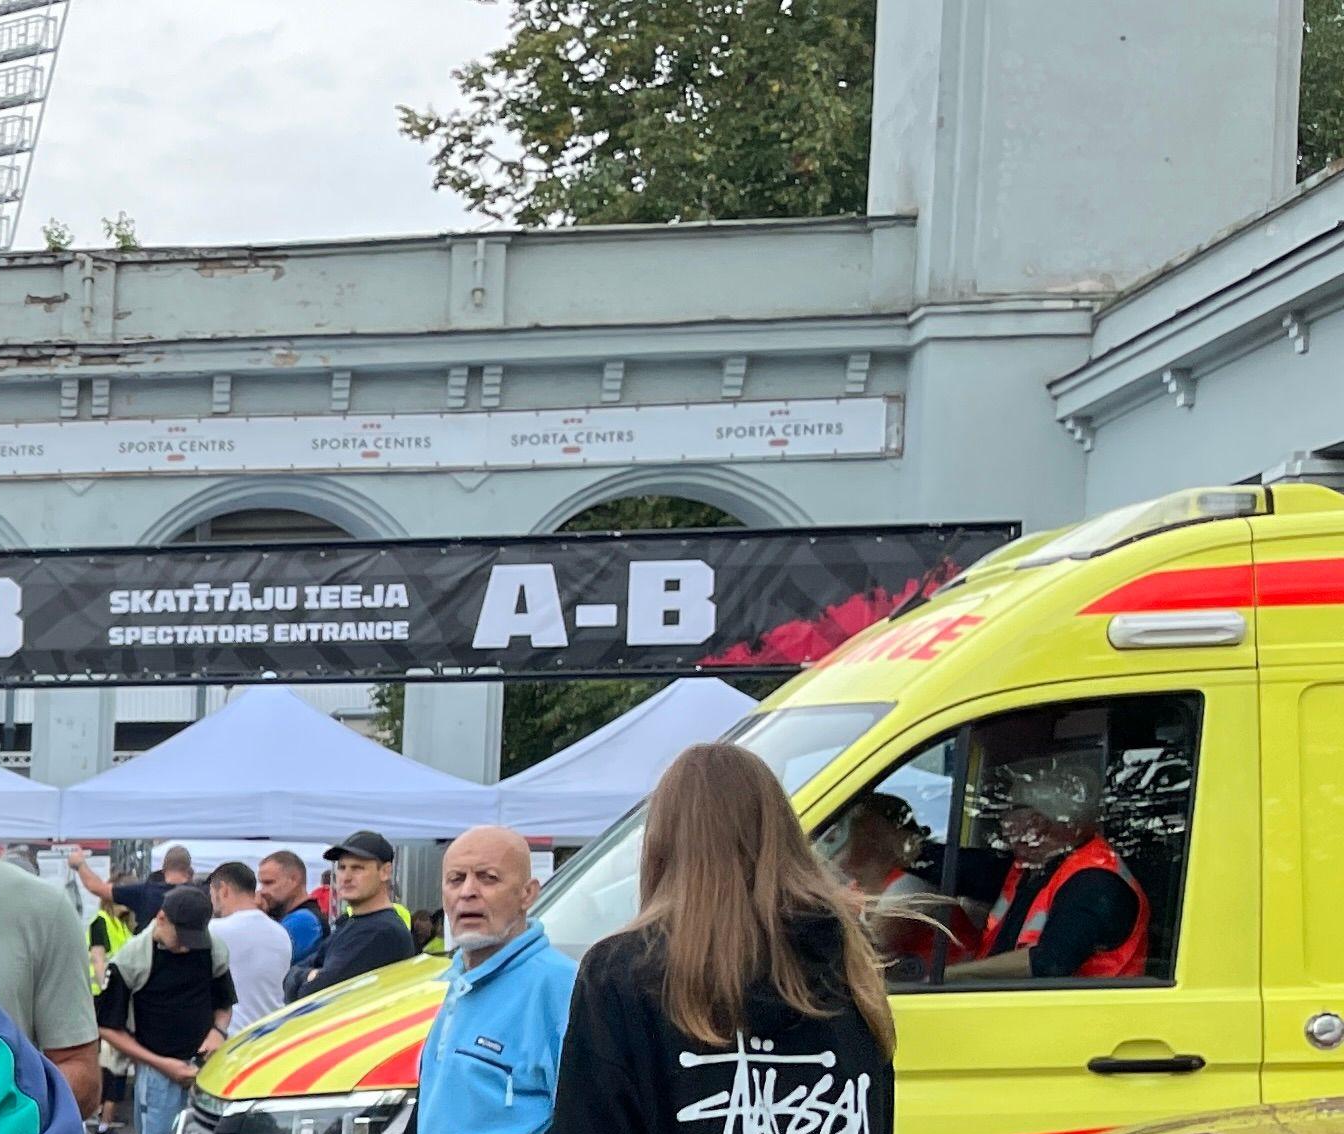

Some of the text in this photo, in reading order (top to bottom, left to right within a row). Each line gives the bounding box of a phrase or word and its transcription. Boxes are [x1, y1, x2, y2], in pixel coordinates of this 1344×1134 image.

[511, 430, 634, 447] SPORTA CENTRS
[716, 422, 844, 440] SPORTA CENTRS
[118, 440, 235, 453] SPORTA CENTRS
[311, 436, 432, 449] SPORTA CENTRS
[109, 582, 410, 615] SKATĪTĀJU IEEJA
[472, 559, 717, 649] A-B
[108, 620, 410, 646] SPECTATORS ENTRANCE
